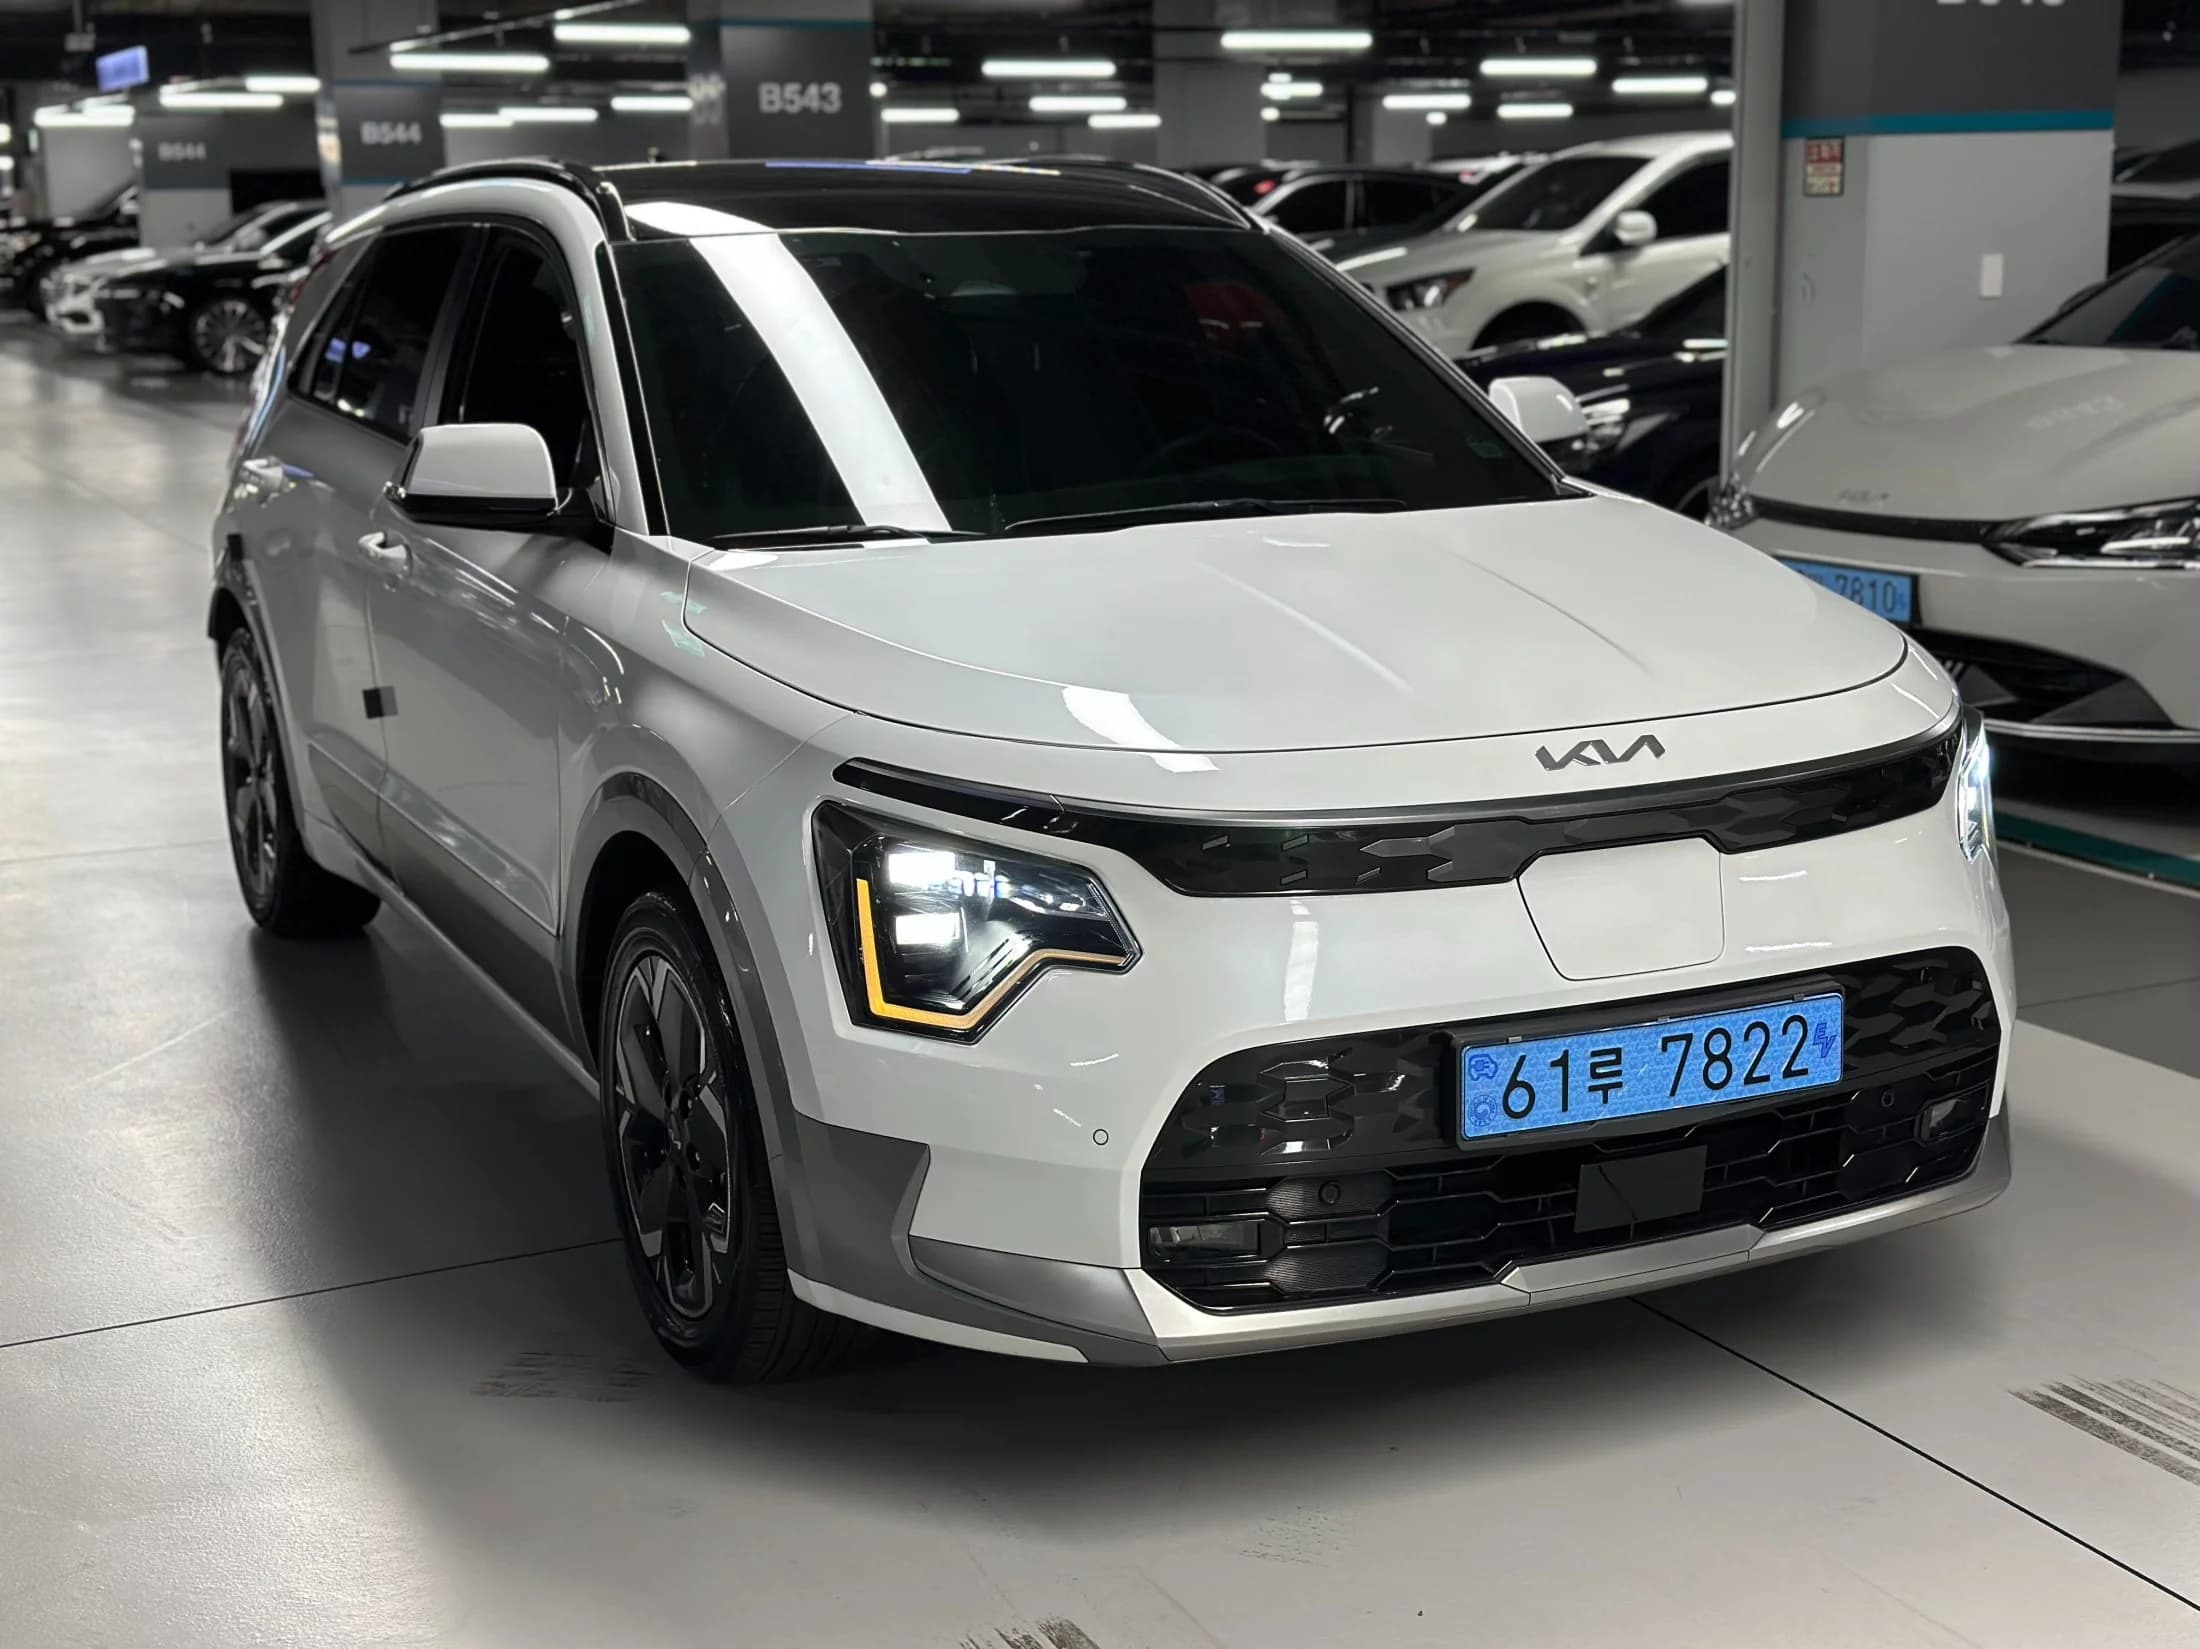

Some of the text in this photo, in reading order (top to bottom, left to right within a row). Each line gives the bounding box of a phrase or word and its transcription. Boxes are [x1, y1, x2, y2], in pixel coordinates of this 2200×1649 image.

[758, 81, 842, 114] B543
[360, 121, 422, 145] B544
[1835, 574, 1897, 613] 7810
[1535, 734, 1666, 772] KIA
[1502, 1047, 1624, 1120] 61루
[1661, 1014, 1809, 1098] 7822
